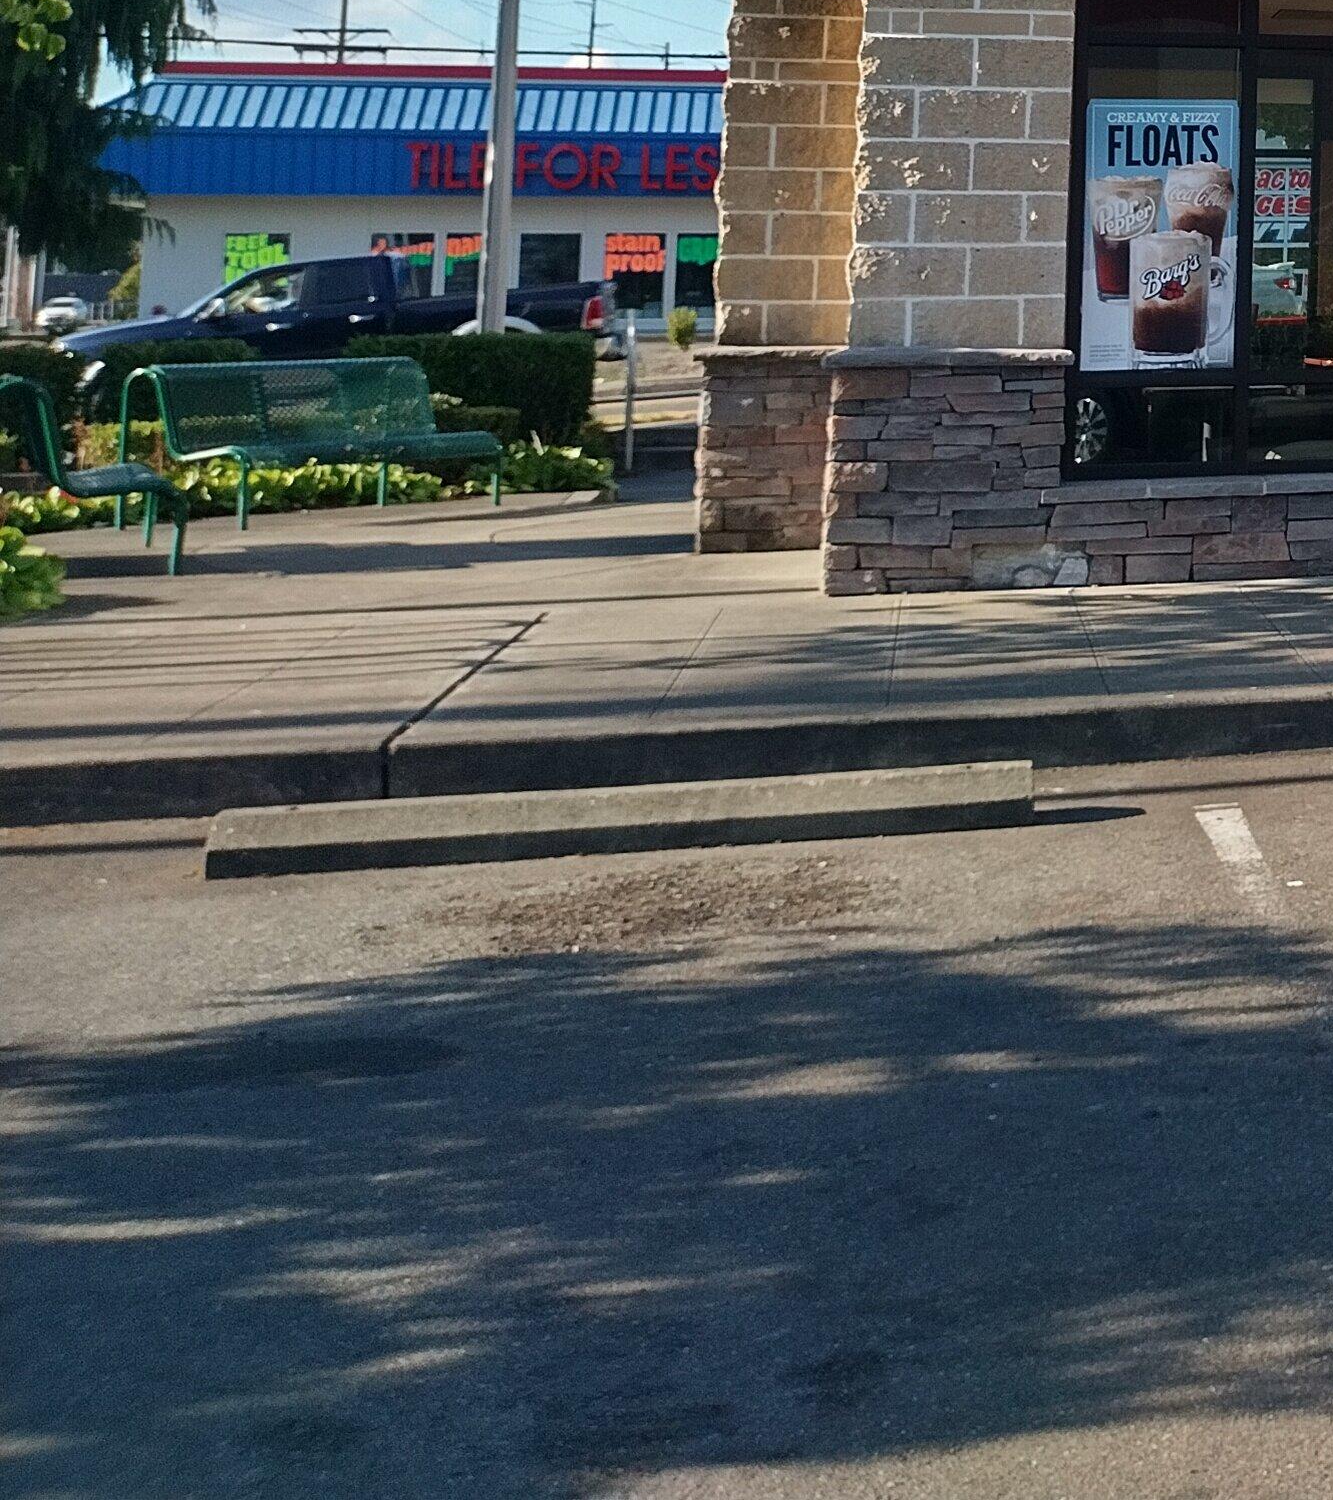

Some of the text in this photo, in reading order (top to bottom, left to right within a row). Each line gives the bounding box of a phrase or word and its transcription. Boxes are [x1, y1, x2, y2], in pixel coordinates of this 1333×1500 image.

[1107, 112, 1221, 123] CREAMY & FIZZY
[1108, 125, 1220, 167] FLOATS
[406, 142, 718, 191] TILE FOR LES
[1099, 203, 1153, 236] Pepper
[1110, 197, 1140, 214] Dr
[605, 233, 661, 253] stain
[604, 249, 666, 280] proof
[1140, 254, 1202, 300] Barq's
